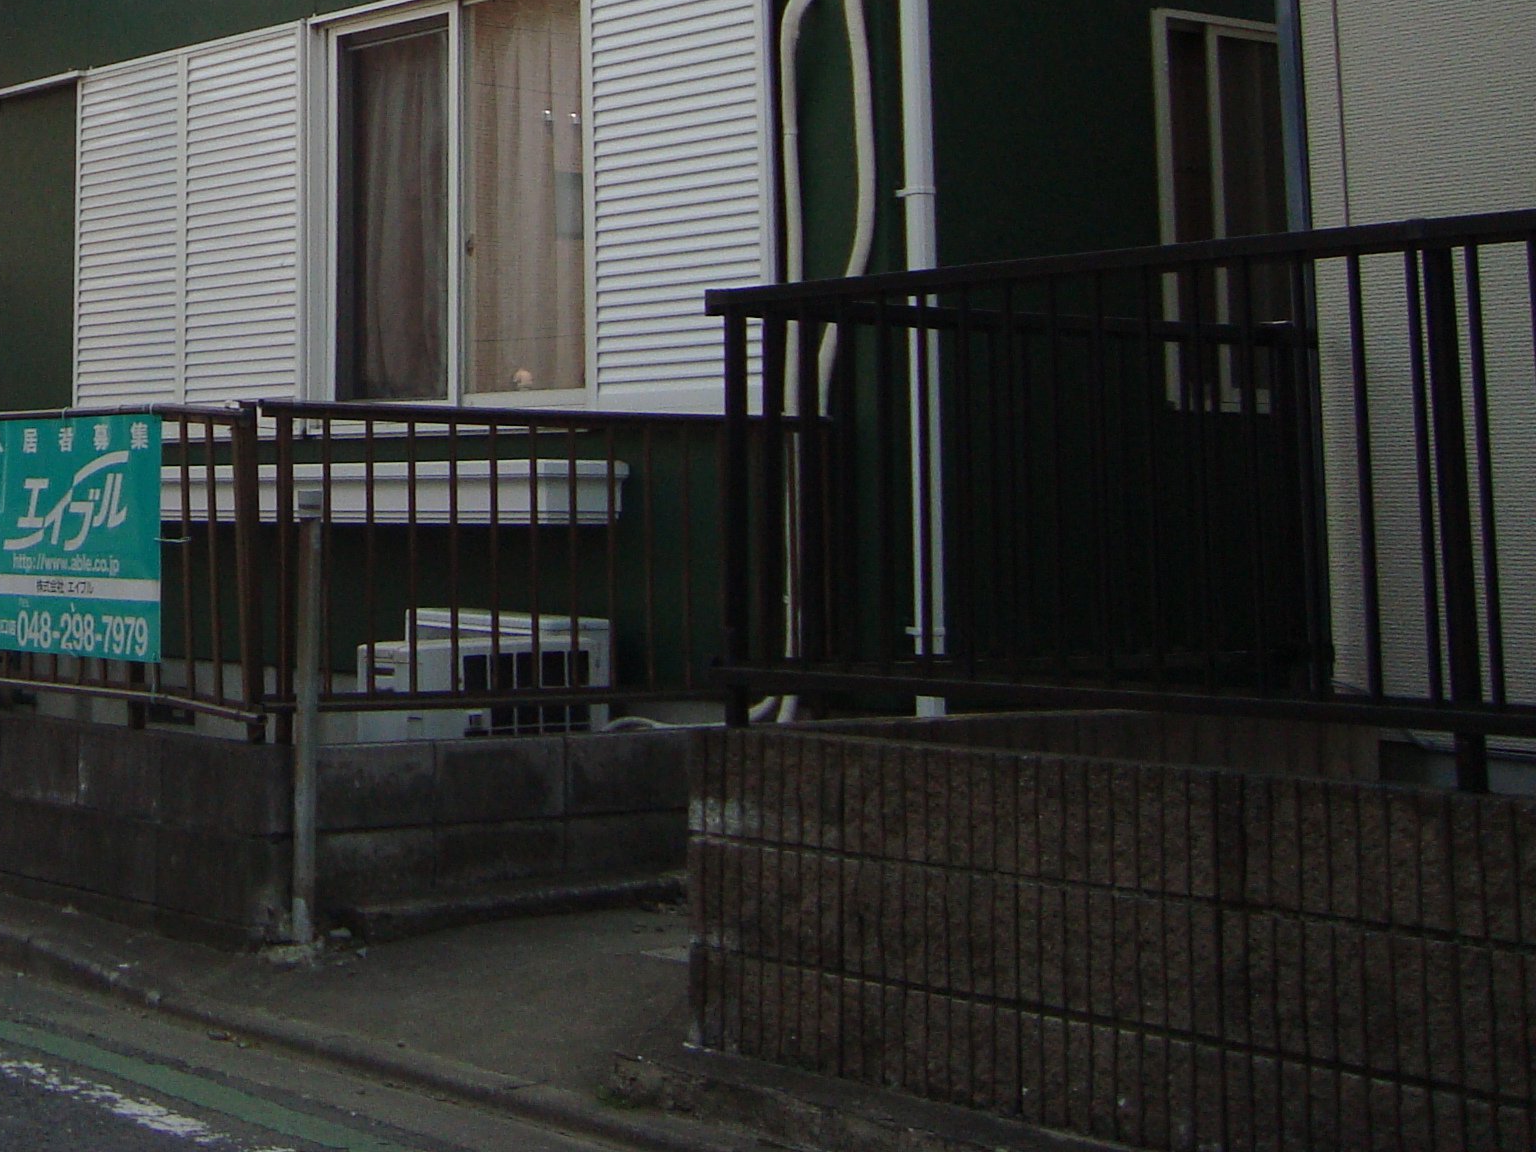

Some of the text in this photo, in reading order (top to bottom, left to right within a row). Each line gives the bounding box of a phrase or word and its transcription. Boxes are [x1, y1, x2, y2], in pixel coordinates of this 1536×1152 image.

[3, 450, 130, 551] エイブル
[17, 609, 149, 657] 048-298-7979
